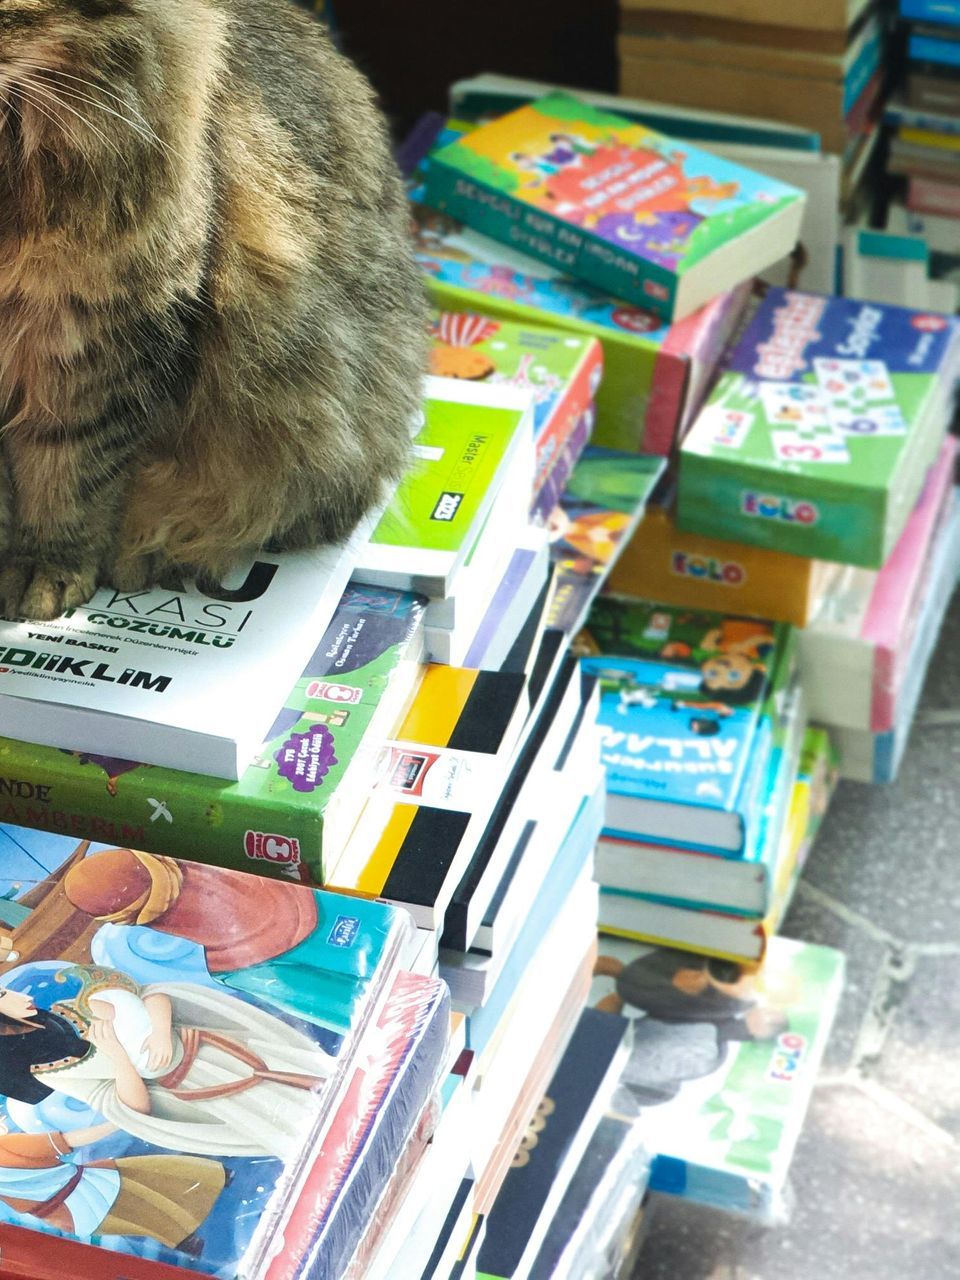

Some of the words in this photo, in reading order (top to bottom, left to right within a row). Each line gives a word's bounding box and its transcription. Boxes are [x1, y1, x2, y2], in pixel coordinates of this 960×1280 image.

[745, 493, 816, 524] EOLO
[674, 552, 743, 584] EOLO
[27, 631, 62, 643] YENİ
[87, 612, 236, 649] ÇÖZÜMLÜ
[124, 637, 200, 657] Düzenlenmiştir
